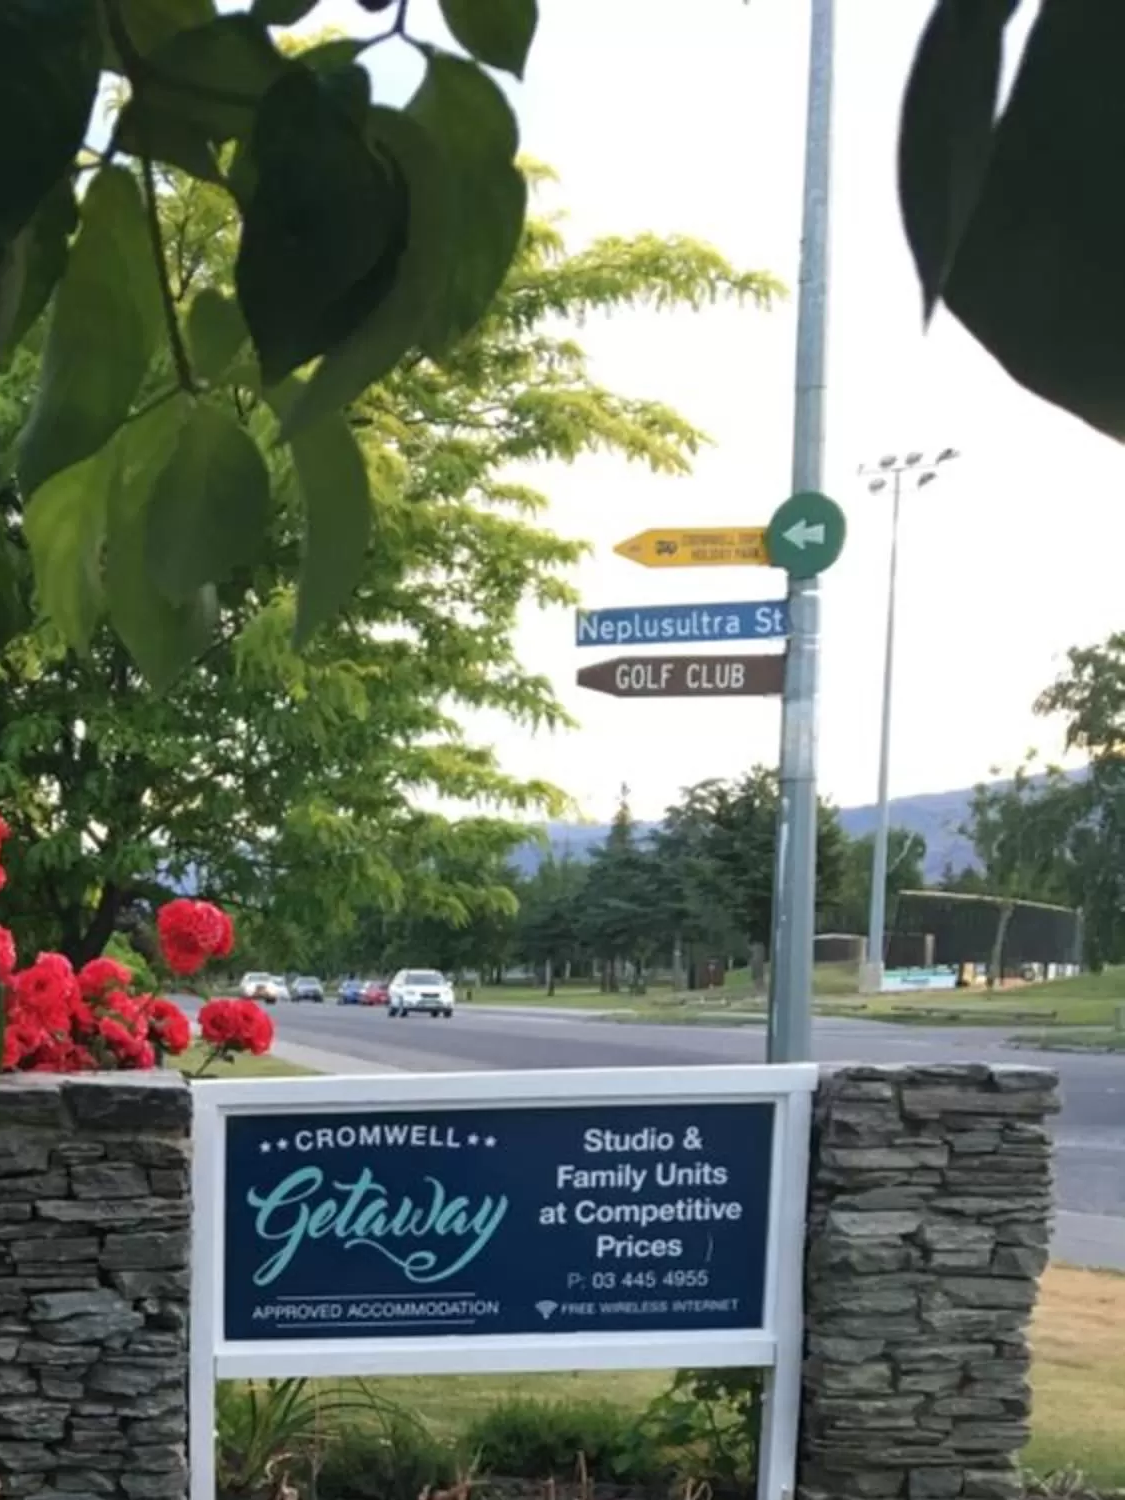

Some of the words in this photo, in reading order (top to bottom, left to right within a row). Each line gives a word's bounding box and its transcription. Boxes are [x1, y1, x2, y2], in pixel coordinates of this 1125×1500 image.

[578, 611, 741, 643] Neplusultra
[755, 606, 784, 633] St
[615, 663, 674, 689] GOLF
[686, 663, 745, 689] CLUB
[295, 1125, 461, 1151] CROMWELL
[583, 1127, 674, 1152] Studio
[682, 1126, 703, 1150] &
[556, 1163, 647, 1192] Family
[655, 1162, 728, 1186] Units
[539, 1202, 567, 1224] at
[574, 1197, 743, 1227] Competitive
[246, 1165, 509, 1286] Getaway
[596, 1234, 683, 1258] Prices
[592, 1272, 616, 1288] 03
[621, 1270, 656, 1287] 445
[662, 1269, 709, 1287] 4955
[252, 1303, 342, 1319] APPROVED
[347, 1300, 500, 1318] ACCOMMODATION
